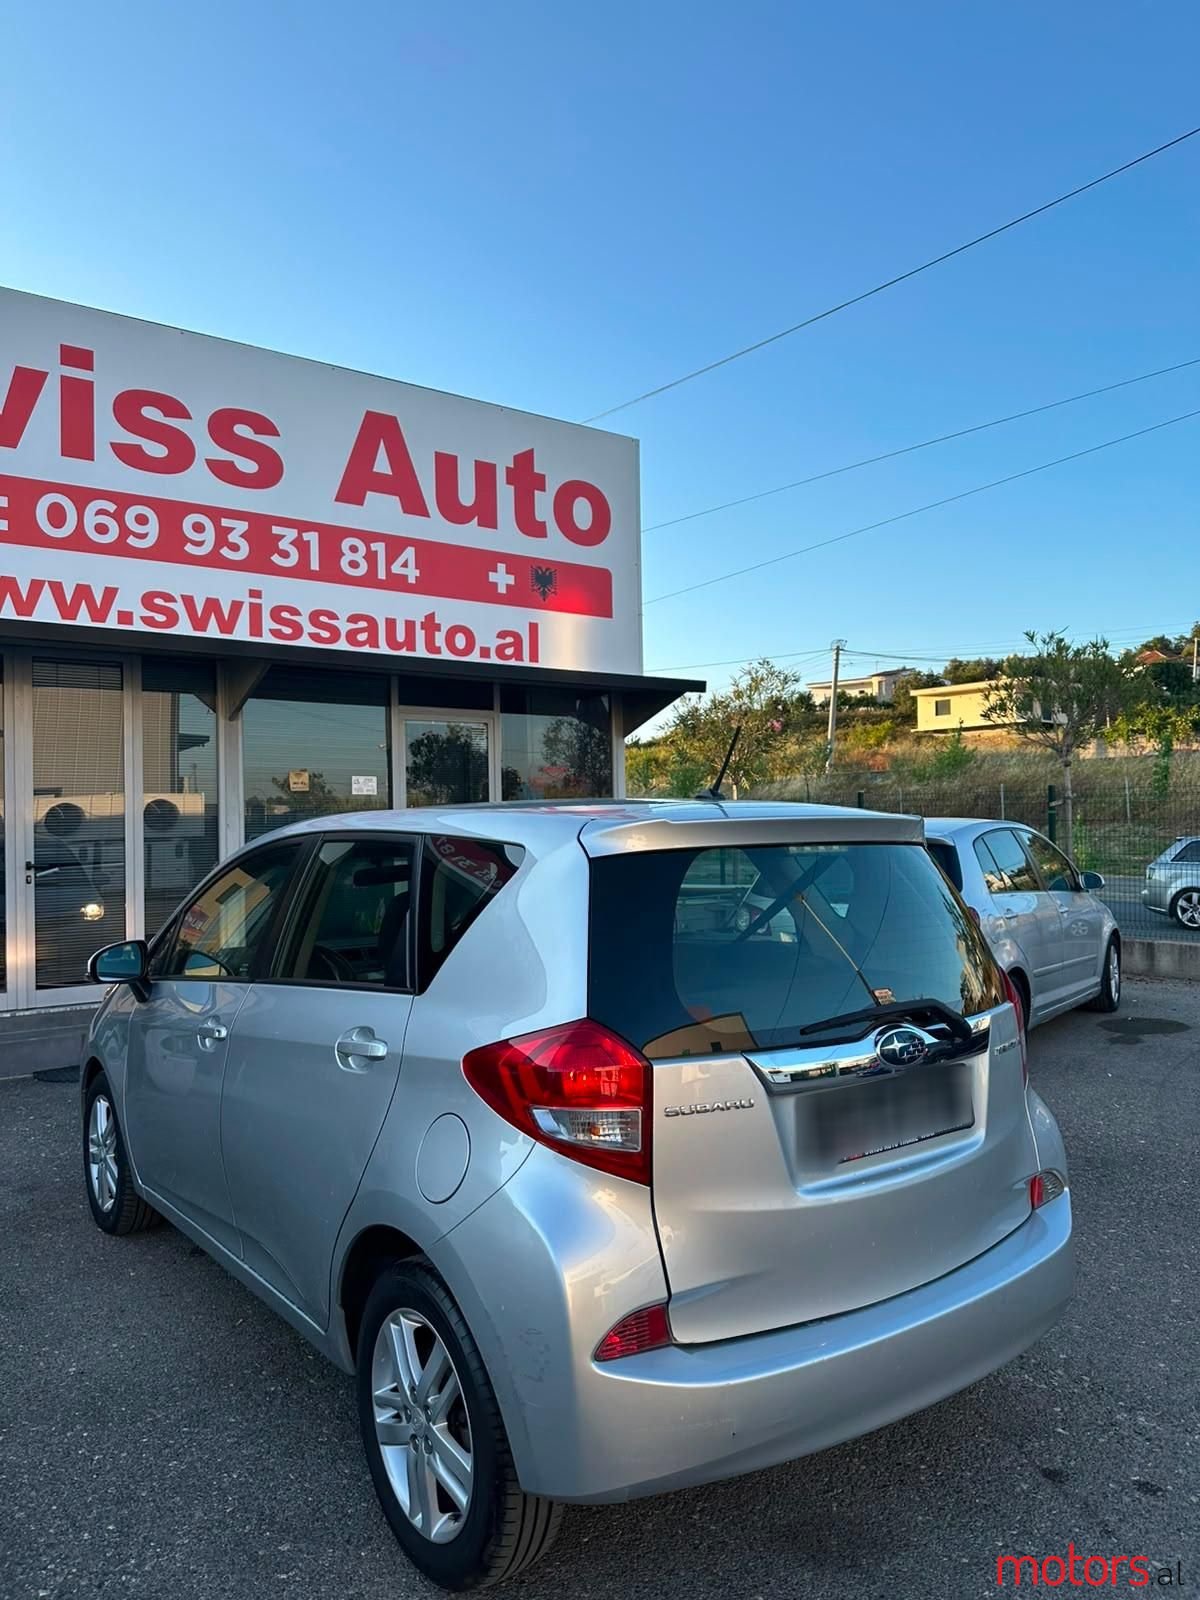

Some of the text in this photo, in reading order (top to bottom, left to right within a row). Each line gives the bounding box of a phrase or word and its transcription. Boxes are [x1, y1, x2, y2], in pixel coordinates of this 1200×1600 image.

[334, 409, 612, 547] Auto
[35, 492, 160, 549] 069
[182, 513, 250, 561] 93
[270, 525, 320, 572] 31
[339, 537, 420, 584] 814
[663, 1098, 755, 1118] SUBARU
